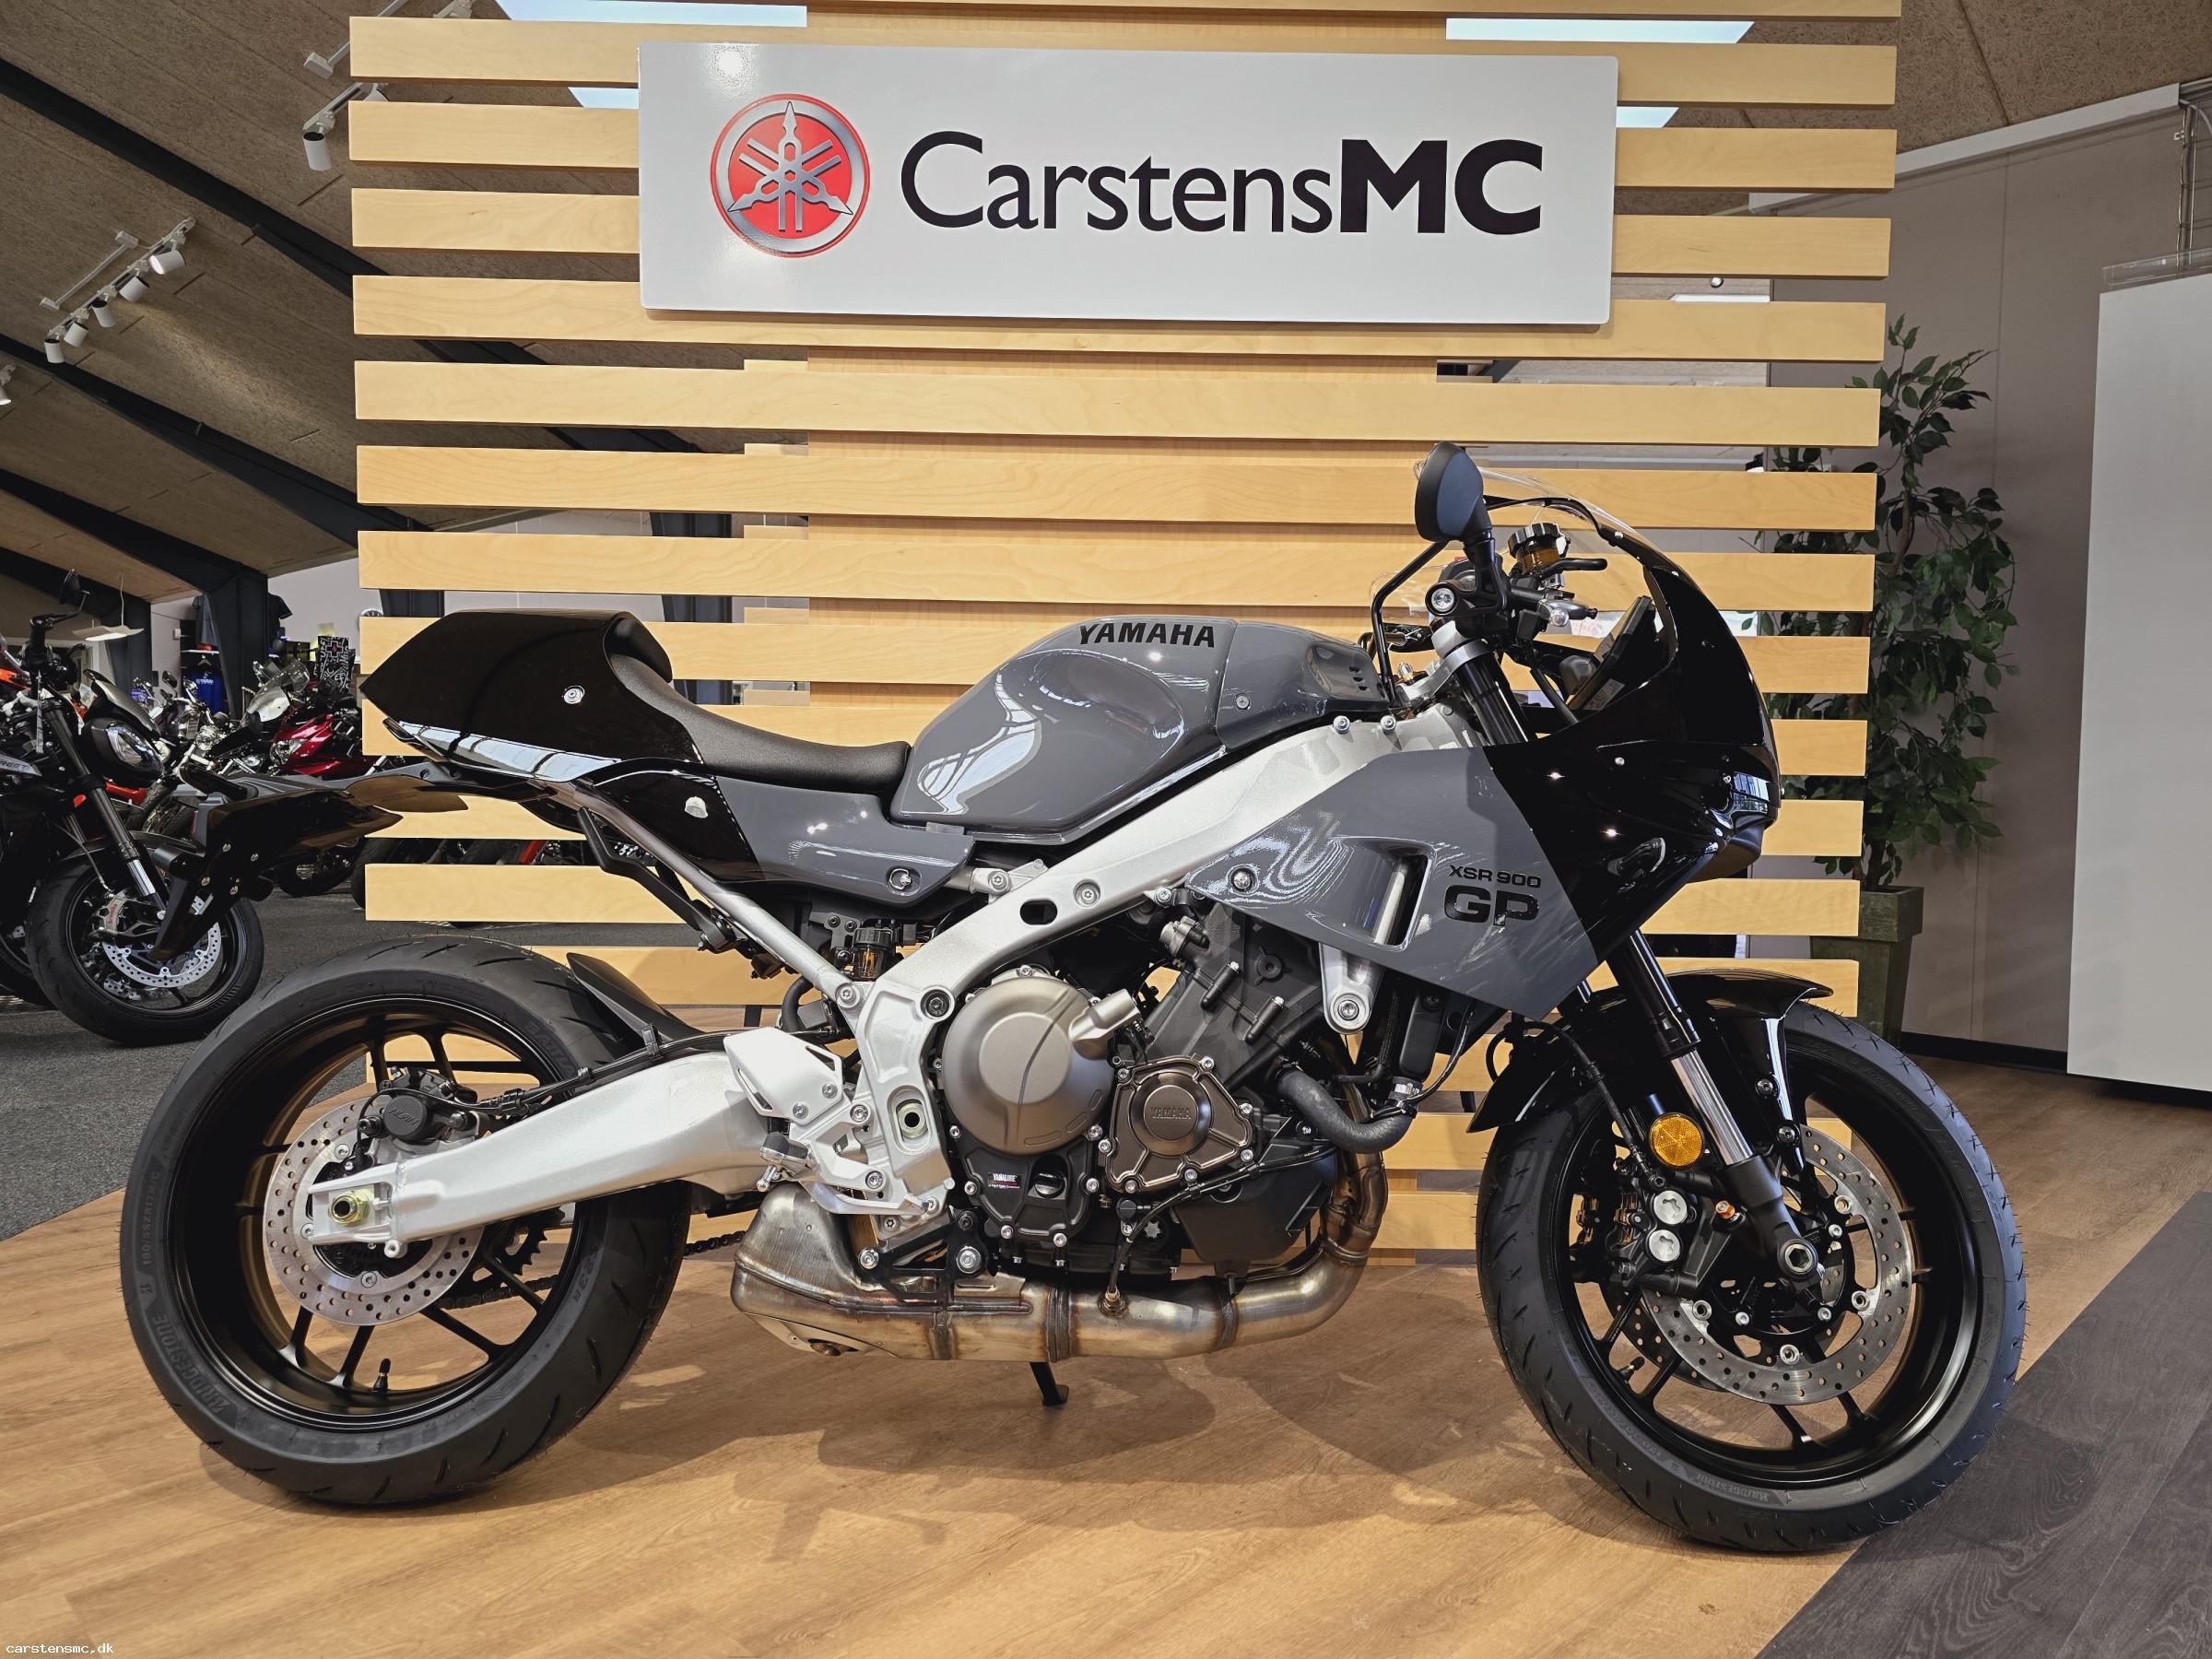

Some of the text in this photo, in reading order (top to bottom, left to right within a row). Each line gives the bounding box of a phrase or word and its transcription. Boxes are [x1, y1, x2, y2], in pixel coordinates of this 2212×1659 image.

[900, 130, 1543, 236] CarstensMC
[1080, 623, 1215, 648] YAMAHA
[1449, 865, 1541, 888] XSR 900
[1443, 885, 1540, 926] GP
[1151, 1106, 1191, 1120] YAMAHA
